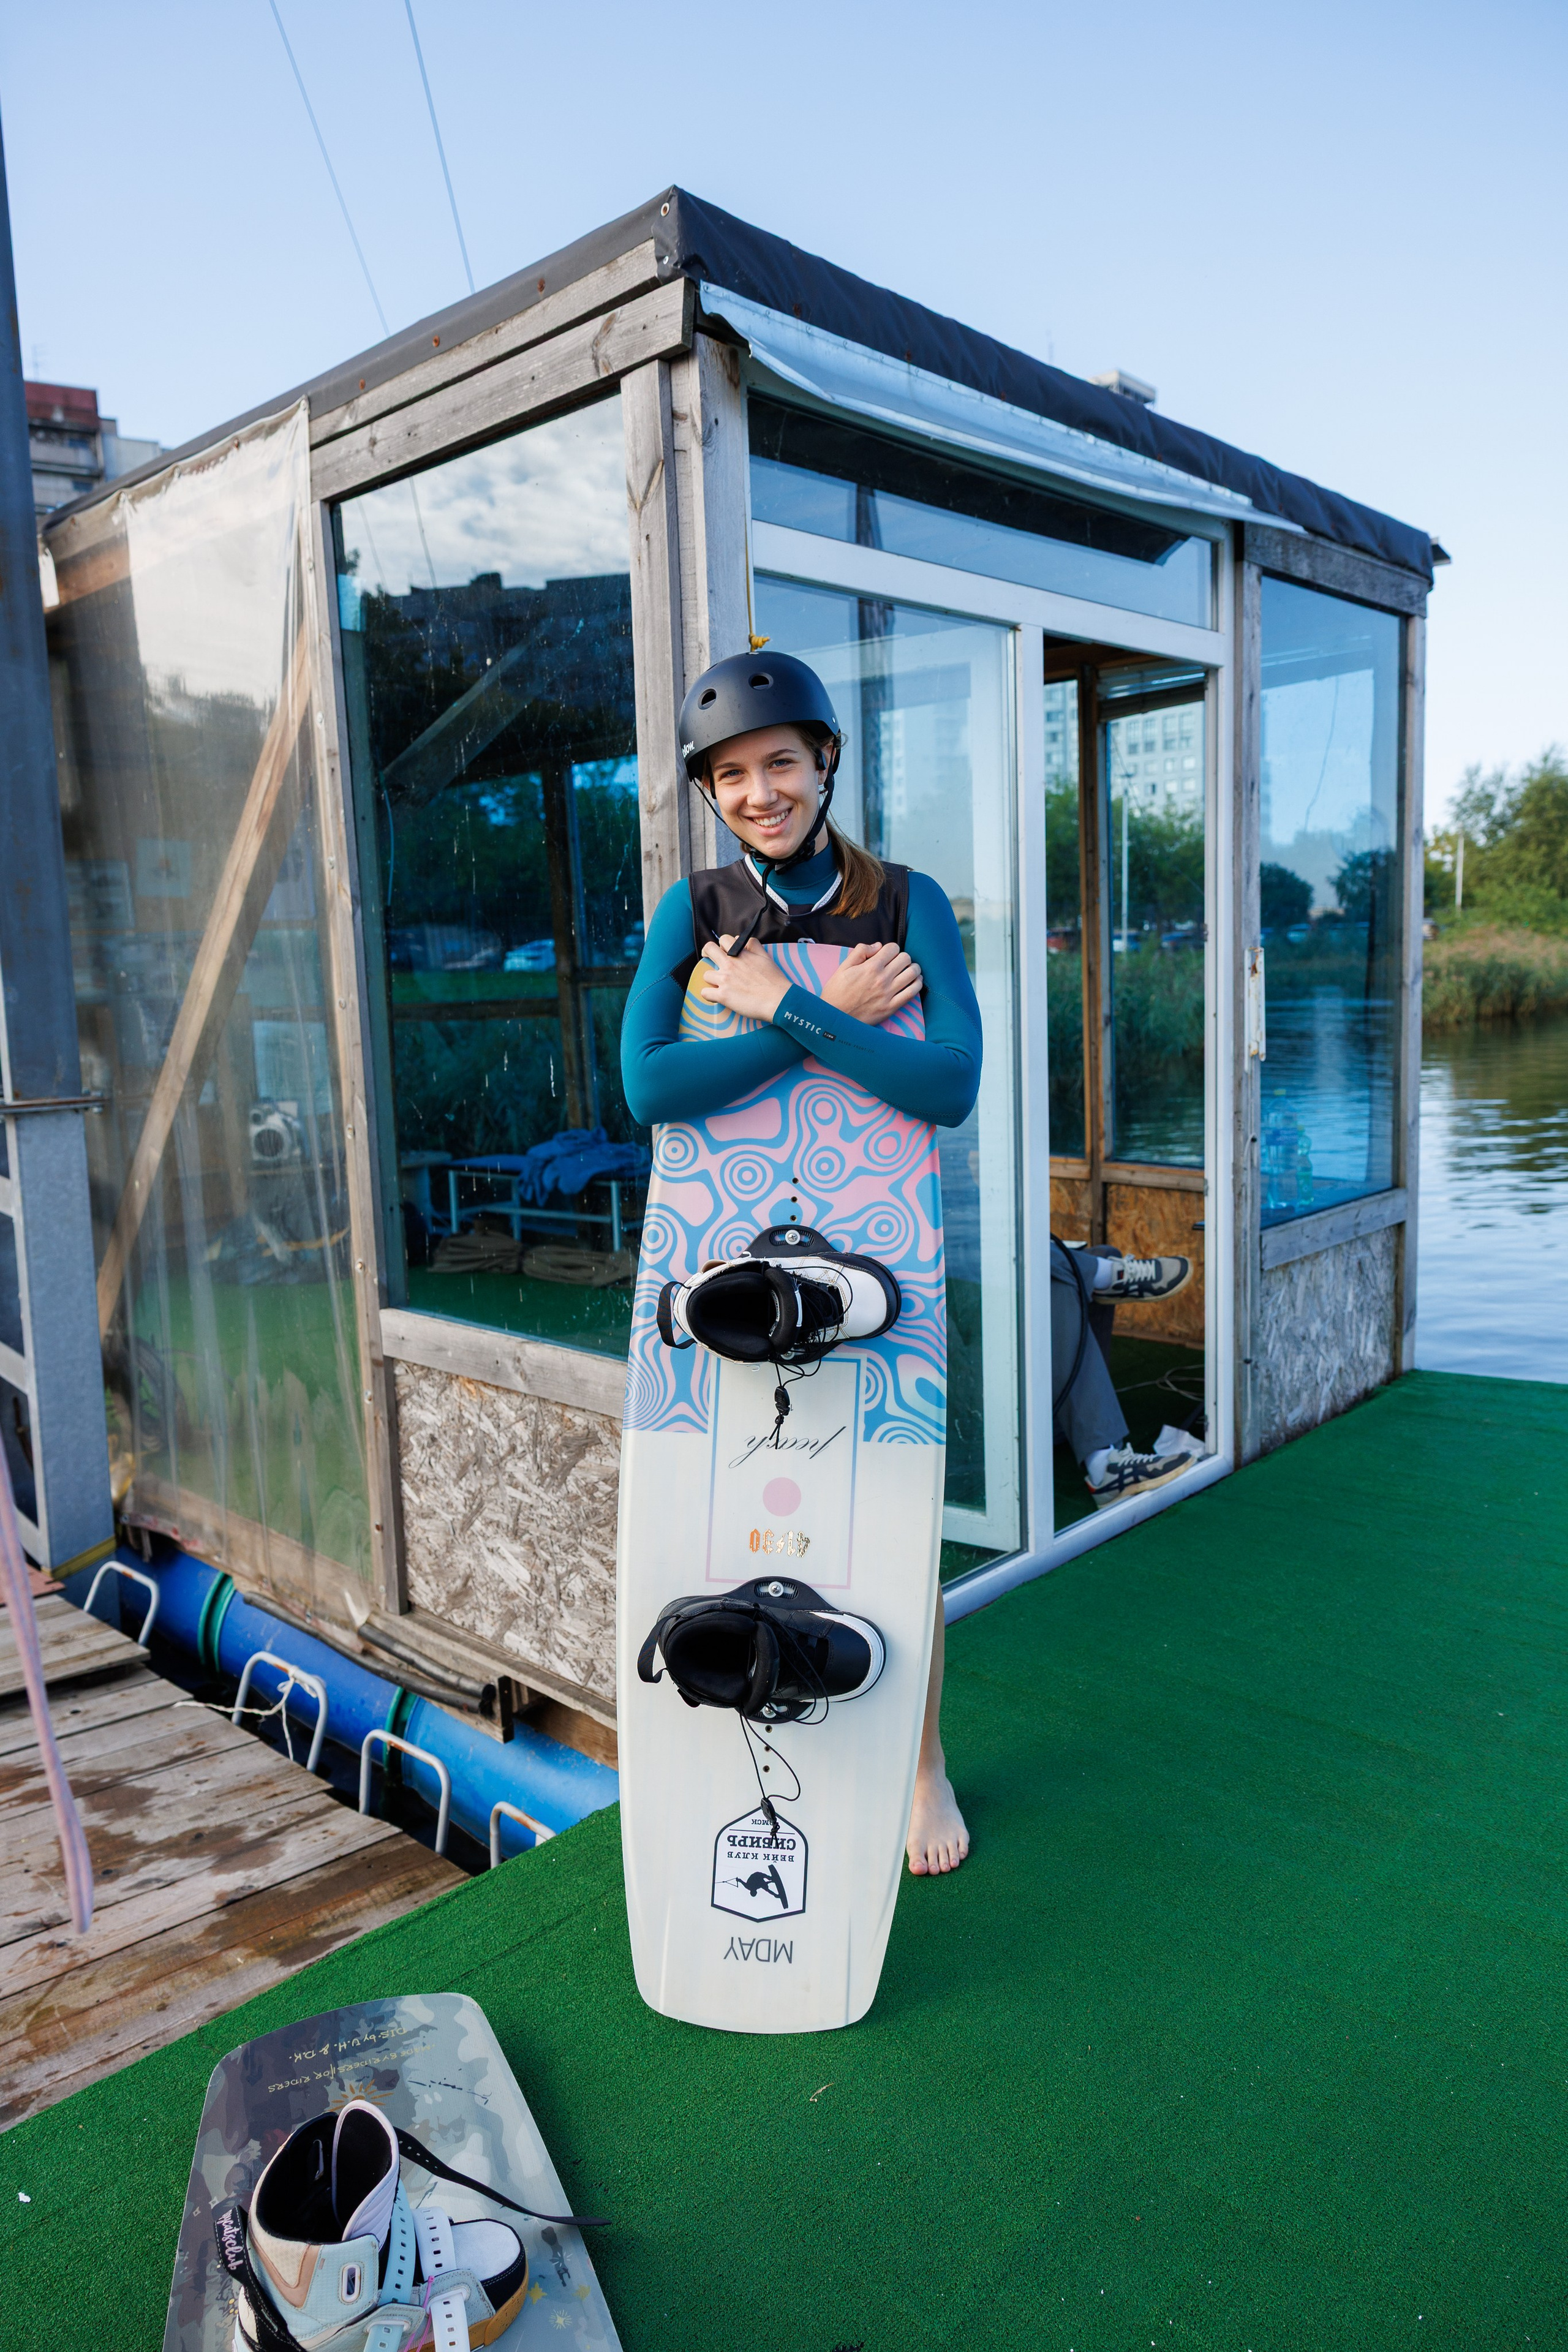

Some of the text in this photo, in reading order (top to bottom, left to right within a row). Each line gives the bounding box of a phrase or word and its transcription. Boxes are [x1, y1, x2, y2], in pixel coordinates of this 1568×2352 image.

[784, 1011, 822, 1035] MYSTIC
[728, 1426, 847, 1469] peach
[726, 1834, 796, 1850] СИБИРЬ
[727, 1852, 794, 1863] ВЕЙК КЛУБ
[723, 1937, 793, 1964] MDAY
[337, 2057, 381, 2073] RIDERS
[268, 2076, 311, 2092] RIDERS
